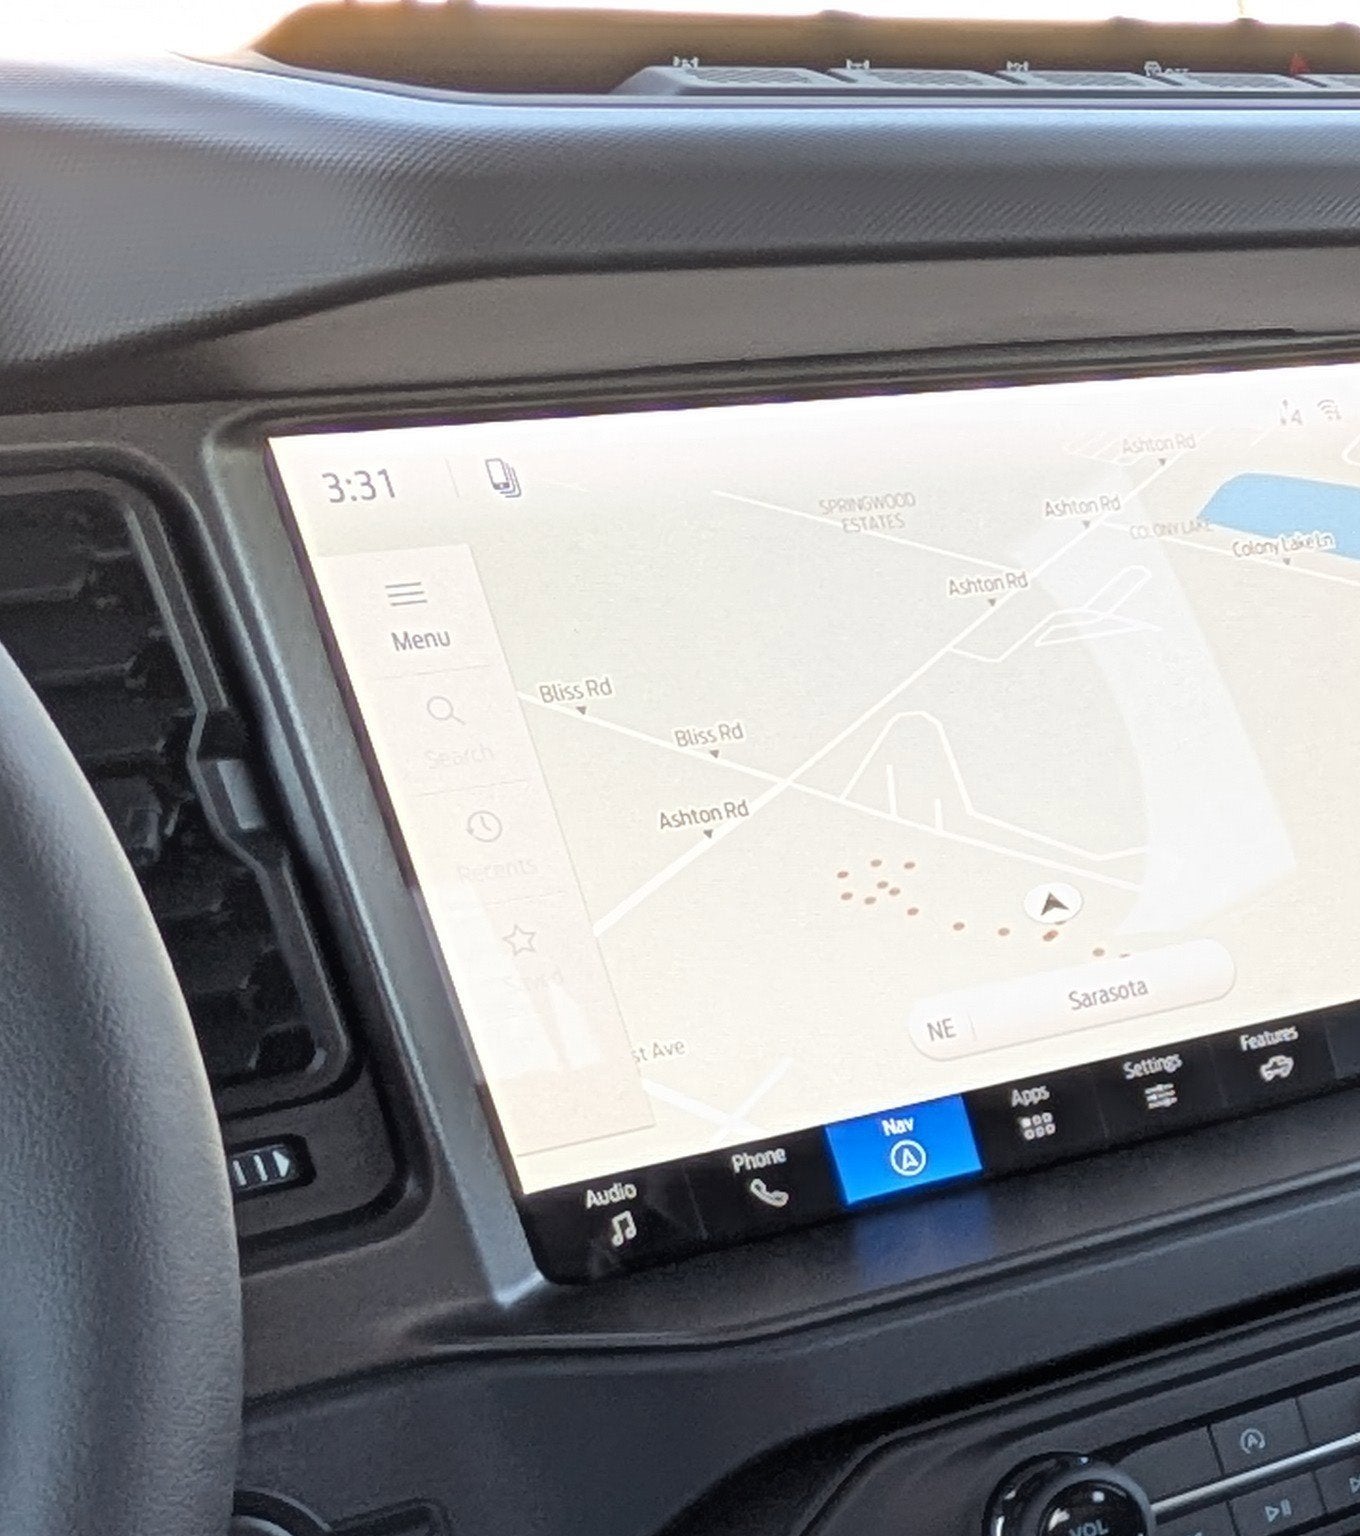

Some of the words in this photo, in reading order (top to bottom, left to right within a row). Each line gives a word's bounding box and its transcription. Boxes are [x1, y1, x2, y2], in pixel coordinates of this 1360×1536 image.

[1122, 434, 1170, 454] Ashton
[1174, 432, 1196, 450] Rd
[321, 467, 397, 504] 3:31
[819, 492, 916, 515] SPRINGWOOD
[1045, 495, 1096, 518] Ashton
[1099, 494, 1121, 513] Rd
[842, 514, 905, 533] ESTATES
[1232, 538, 1279, 560] Colony
[949, 574, 1004, 596] Ashton
[1007, 571, 1028, 590] Rd
[391, 628, 451, 651] Menu
[539, 681, 584, 704] Bliss
[587, 677, 613, 699] Rd
[674, 726, 718, 749] Bliss
[719, 722, 744, 742] Rd
[660, 804, 721, 830] Ashton
[723, 799, 749, 819] Rd
[1068, 977, 1149, 1012] Sarasota
[927, 1018, 956, 1042] NE
[1240, 1024, 1298, 1052] Features
[632, 1044, 647, 1062] st
[652, 1039, 685, 1059] Ave
[1123, 1052, 1183, 1081] Settings
[1011, 1085, 1050, 1108] Apps
[882, 1114, 914, 1136] Nav
[731, 1145, 786, 1174] Phone
[585, 1181, 636, 1208] Audio
